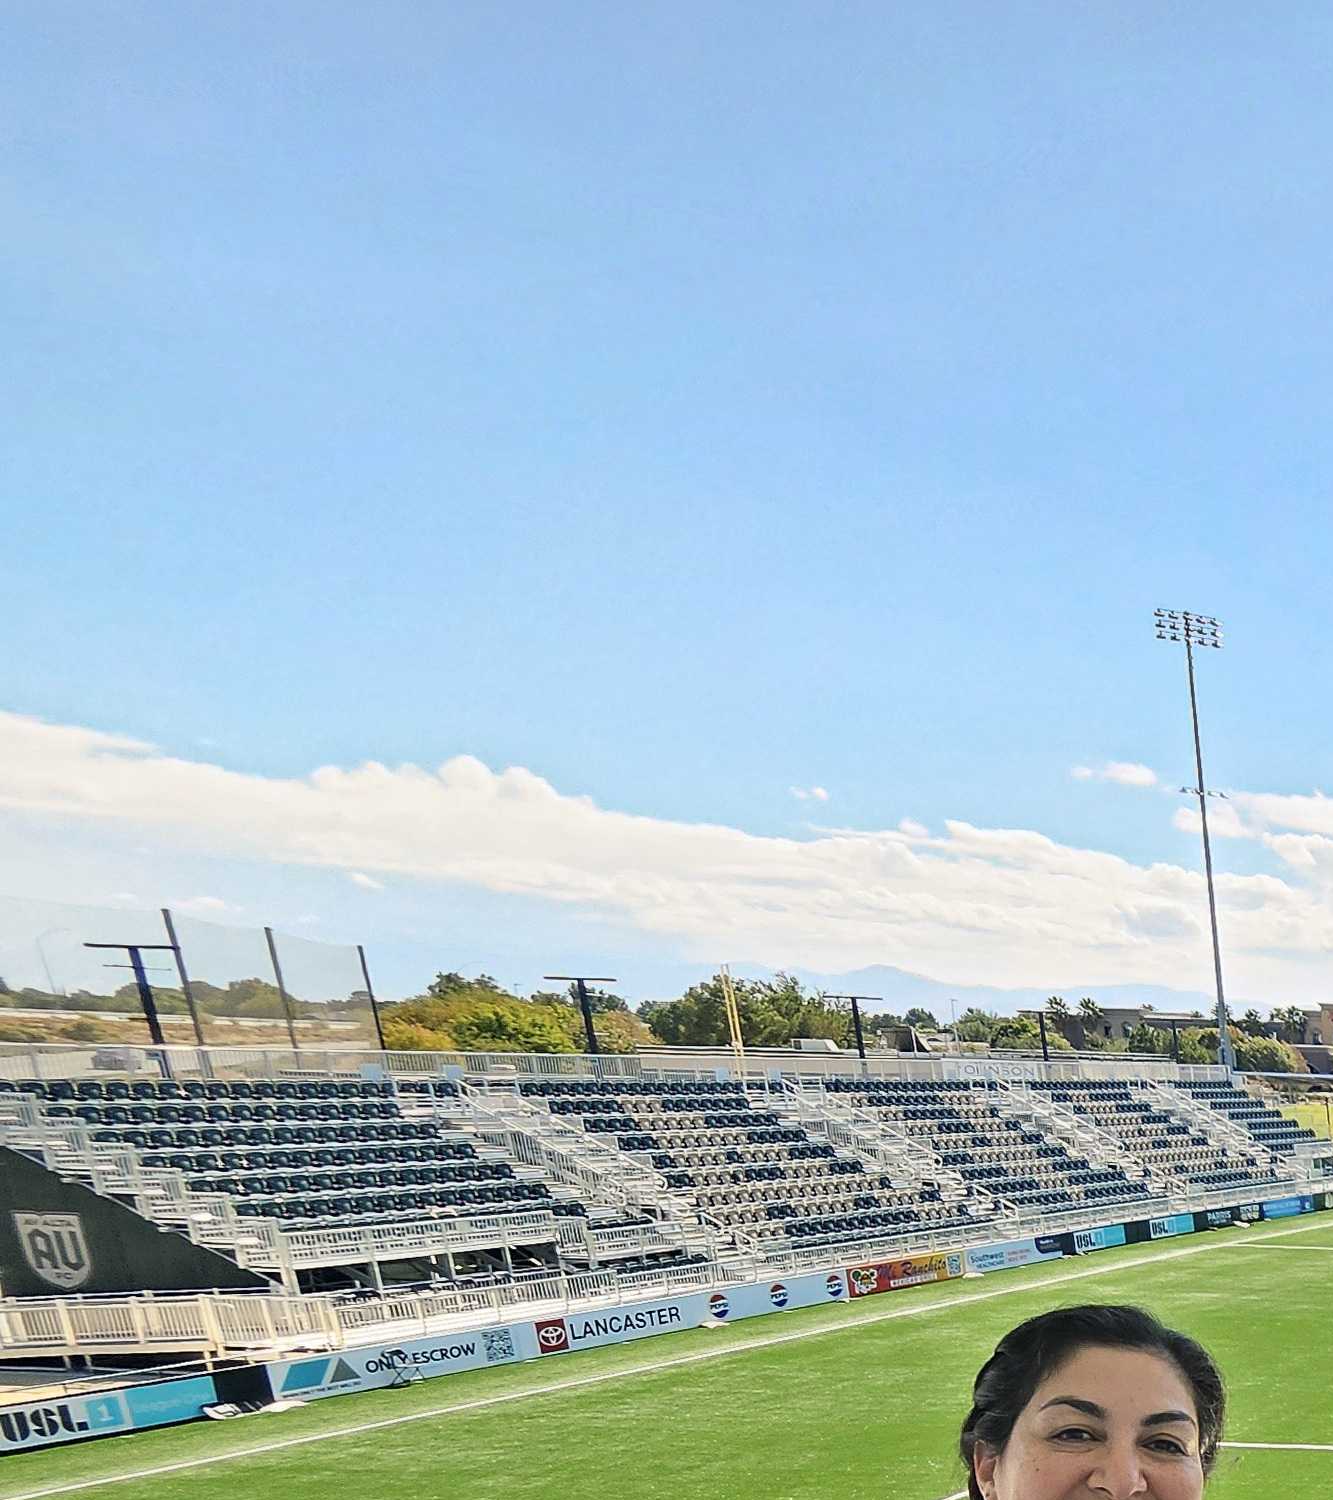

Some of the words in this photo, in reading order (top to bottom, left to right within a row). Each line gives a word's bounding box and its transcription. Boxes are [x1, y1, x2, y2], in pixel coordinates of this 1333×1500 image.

[1151, 1220, 1169, 1235] USL
[1075, 1233, 1096, 1249] USL
[709, 1301, 729, 1311] PEPSI
[569, 1306, 681, 1340] LANCASTER
[412, 1343, 477, 1364] ESCROW
[0, 1404, 90, 1442] USL
